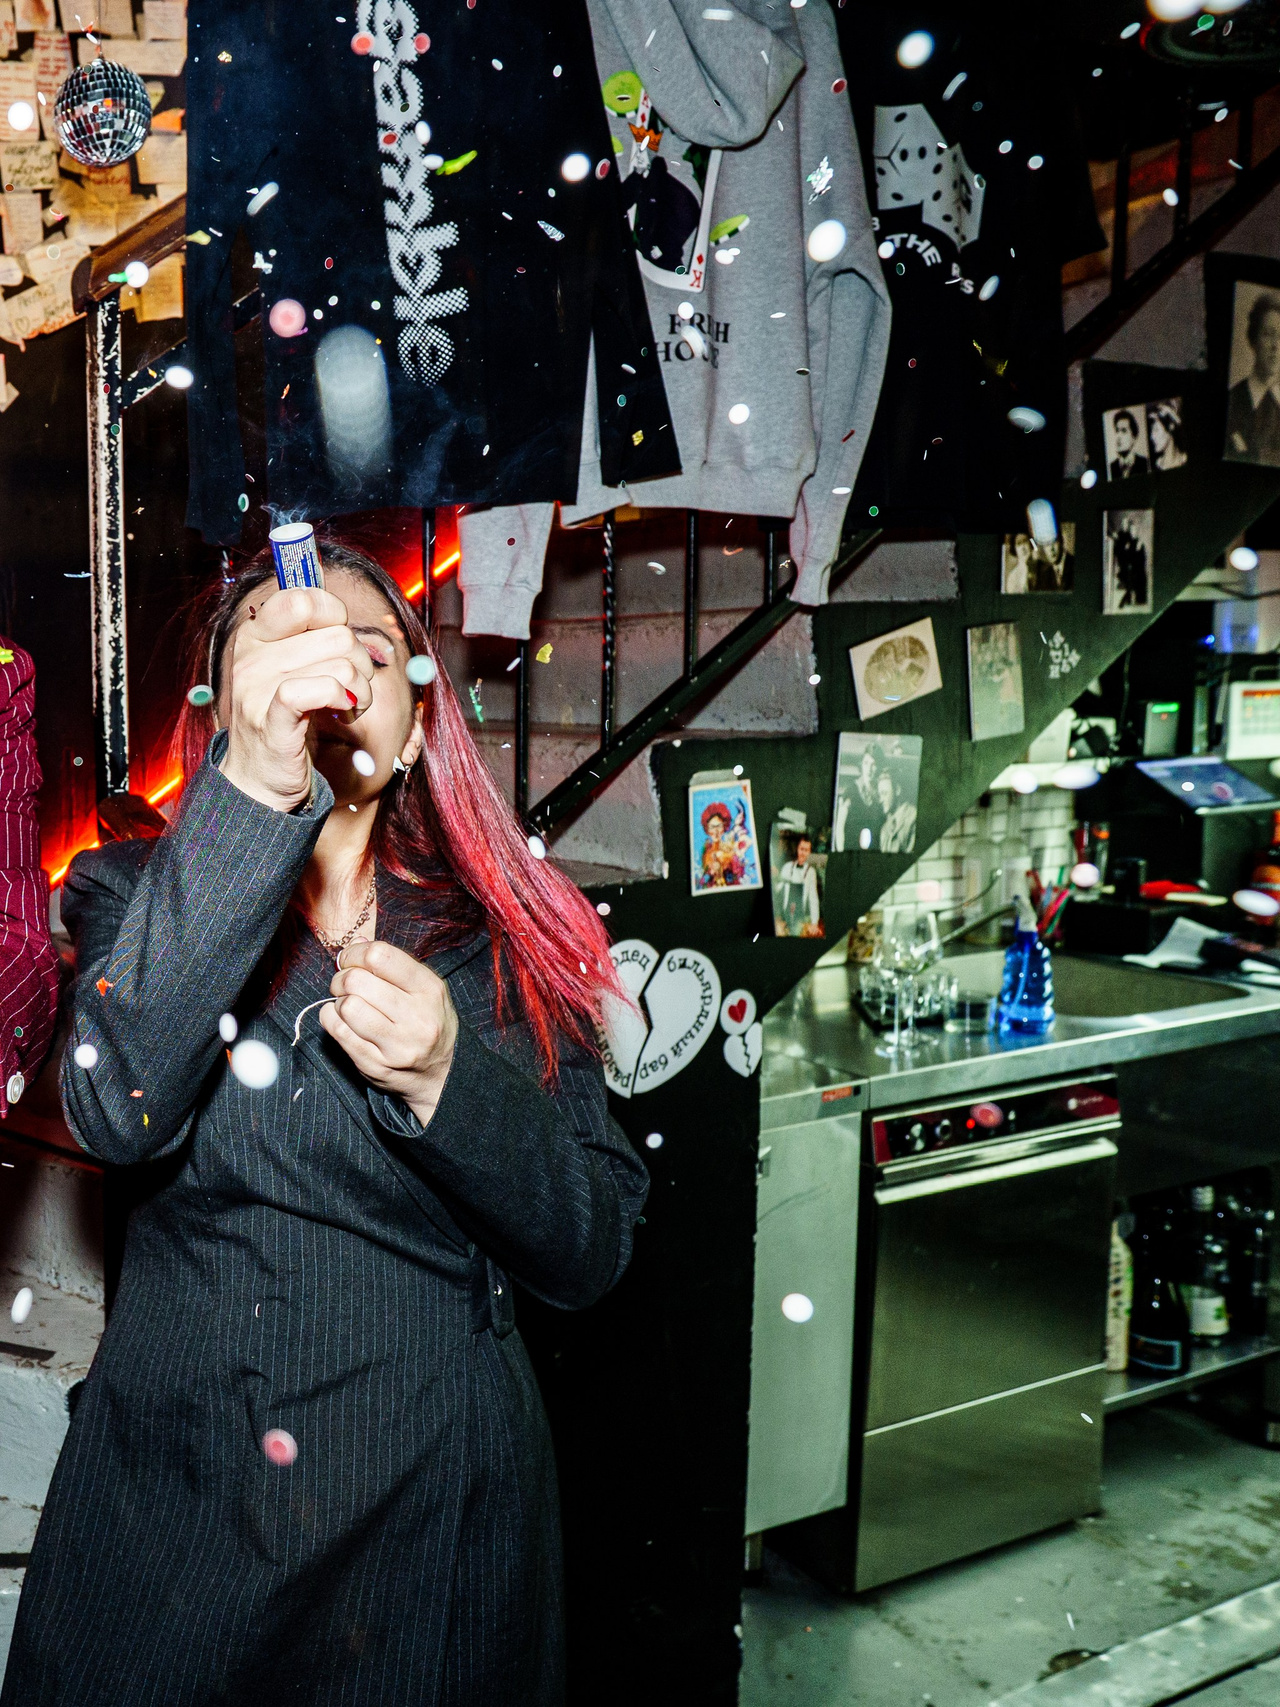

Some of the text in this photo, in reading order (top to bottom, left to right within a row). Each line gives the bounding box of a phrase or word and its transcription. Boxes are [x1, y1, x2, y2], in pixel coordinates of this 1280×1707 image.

[885, 233, 942, 267] THE
[668, 312, 731, 343] FRH
[667, 956, 713, 1058] бильярдный
[640, 1053, 669, 1079] бар
